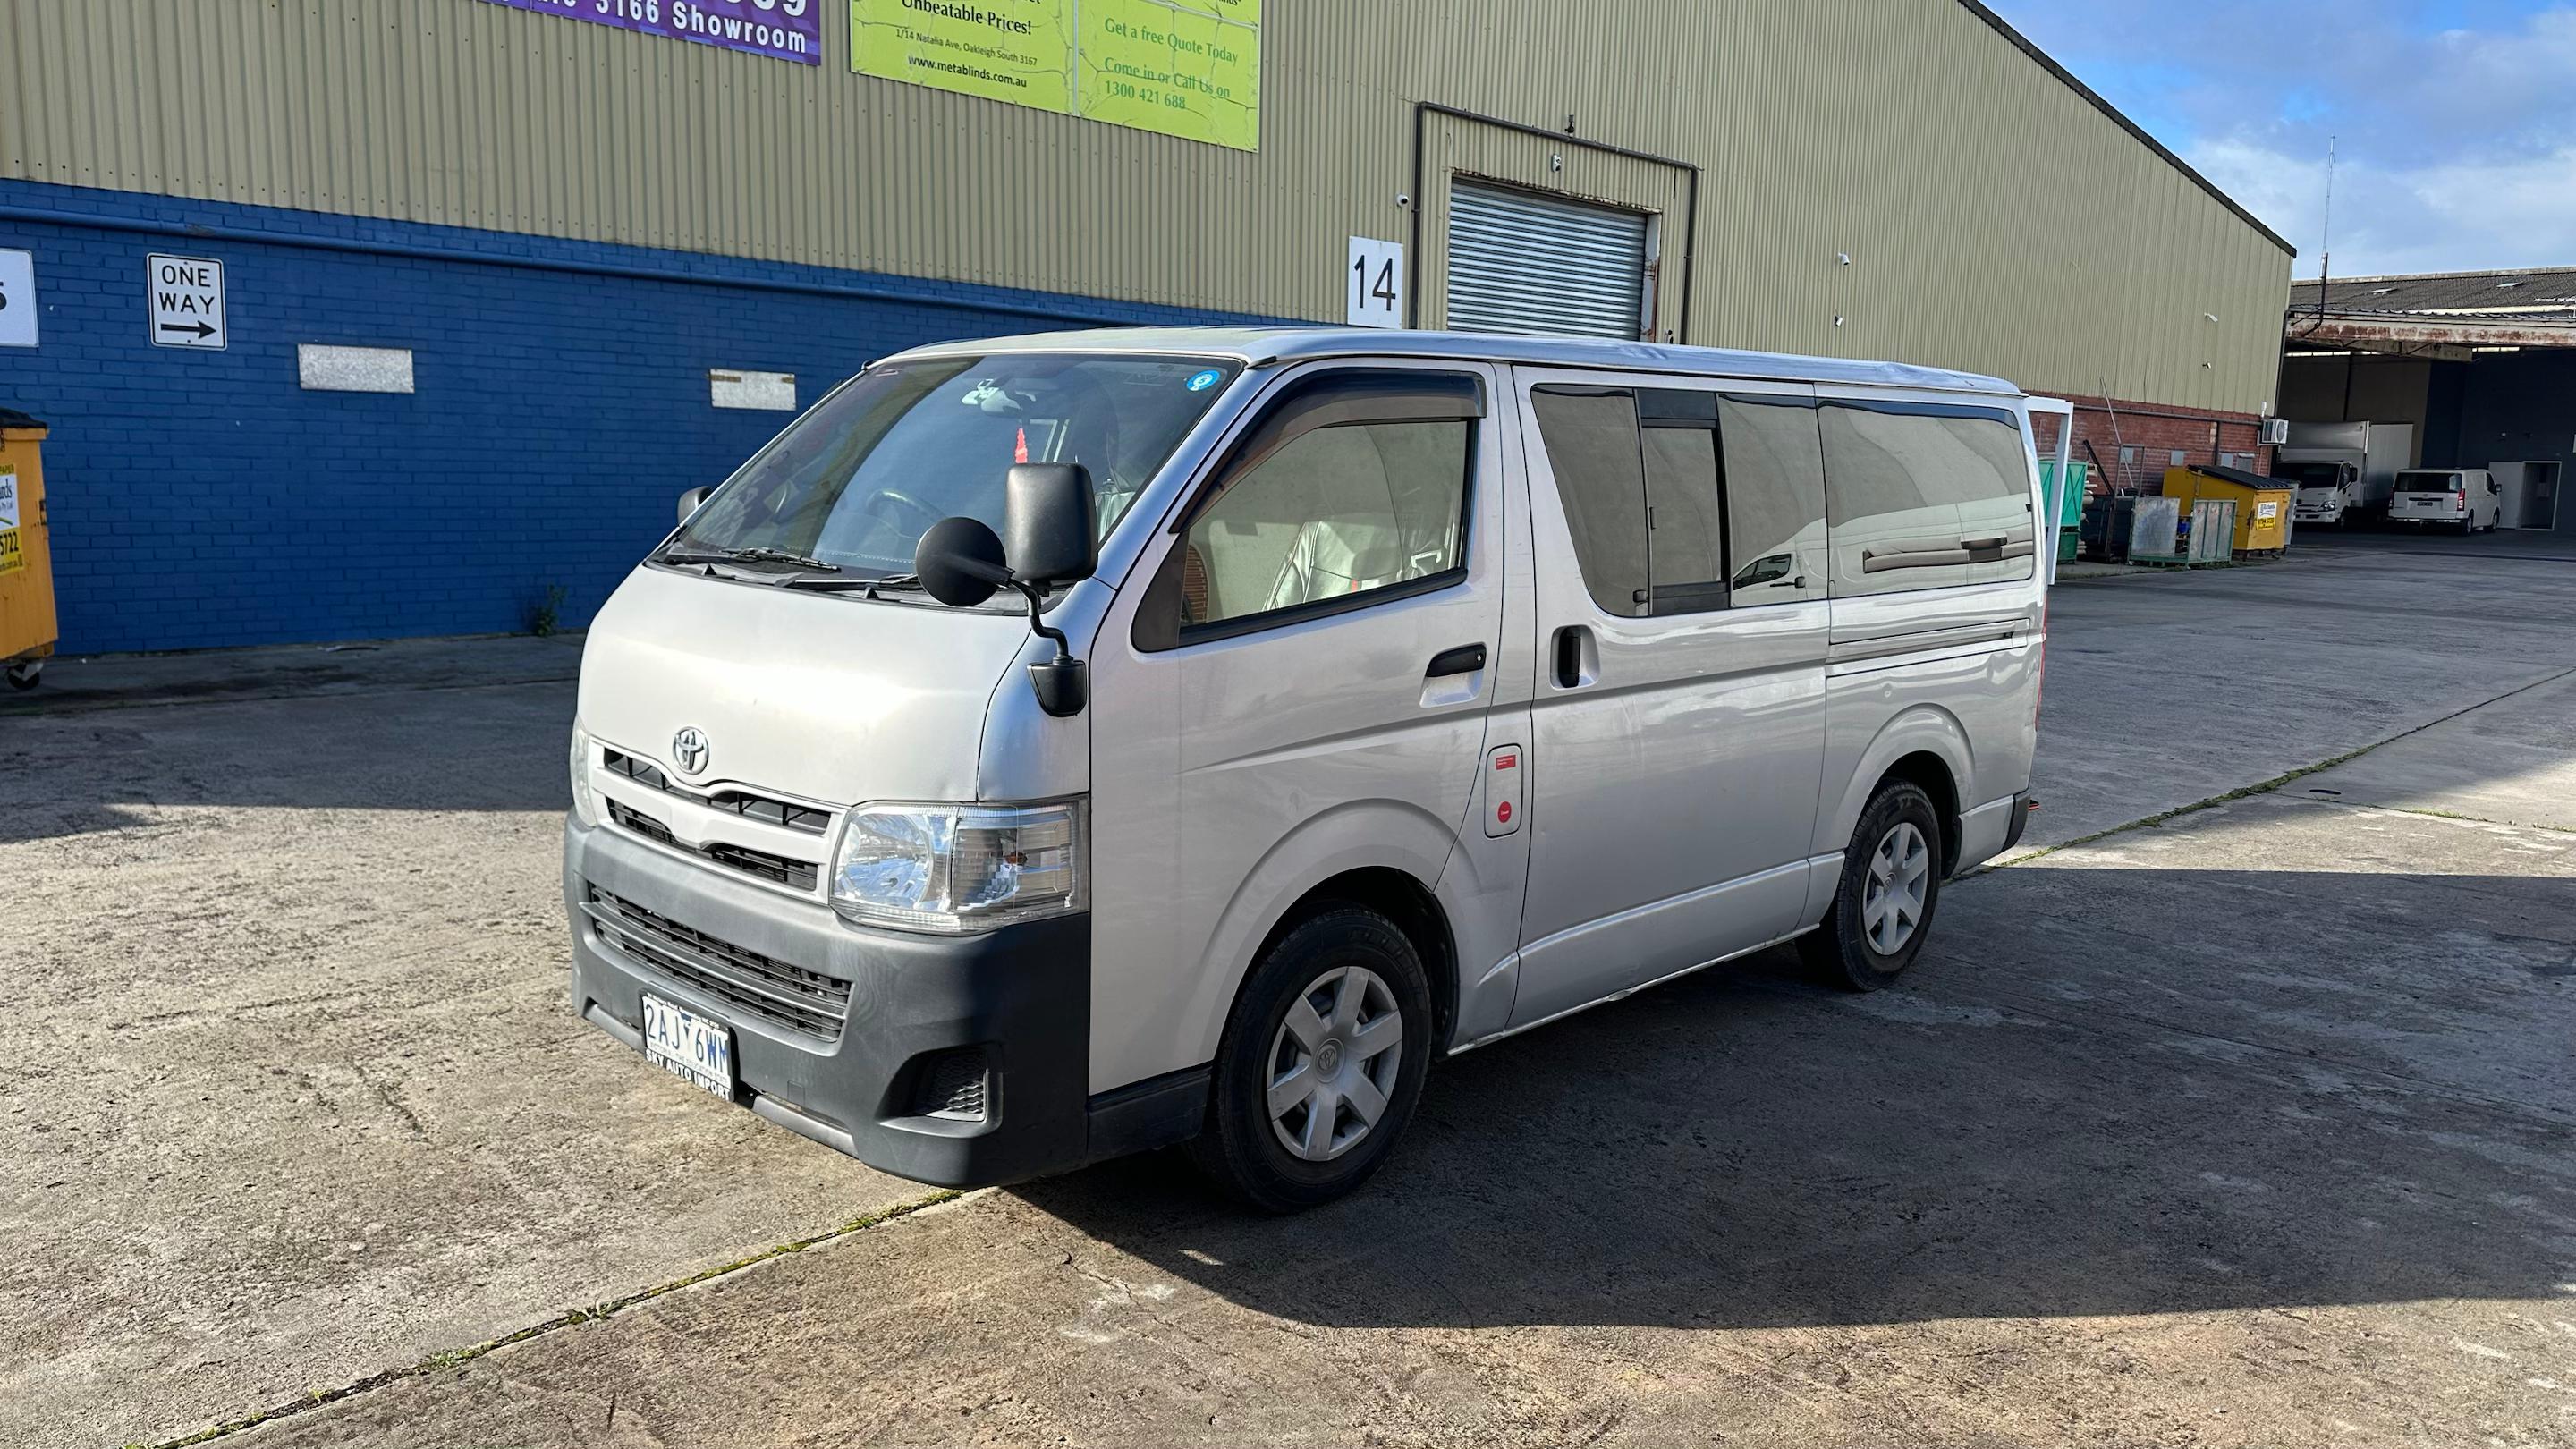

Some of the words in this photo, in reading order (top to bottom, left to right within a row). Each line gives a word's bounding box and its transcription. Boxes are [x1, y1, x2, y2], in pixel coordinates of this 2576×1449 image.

[673, 1, 805, 53] Showroom
[987, 12, 1031, 35] Prices!
[1105, 17, 1127, 37] Get
[1131, 28, 1138, 38] a
[1141, 26, 1164, 44] free
[1167, 33, 1203, 54] Quote
[1206, 43, 1238, 67] Today
[896, 29, 914, 39] 1/14
[916, 33, 944, 46] Natalia
[945, 39, 962, 52] Ave,
[963, 43, 996, 58] Oakleigh
[997, 50, 1019, 63] South
[1020, 55, 1038, 66] 3167
[908, 55, 1027, 88] www.metablinds.com.au
[1105, 57, 1140, 75] Come
[1144, 64, 1154, 80] in
[1158, 73, 1171, 85] or
[1174, 73, 1196, 90] Call
[1199, 80, 1214, 94] Us
[1216, 86, 1230, 97] on
[1105, 80, 1135, 98] 1300
[1139, 89, 1159, 104] 421
[1165, 94, 1186, 109] 688
[162, 265, 211, 288] ONE
[1353, 255, 1396, 311] 14
[158, 292, 215, 315] WAY
[645, 1048, 665, 1067] SKY
[666, 1058, 692, 1082] AUTO
[694, 1072, 730, 1102] IMPORT
